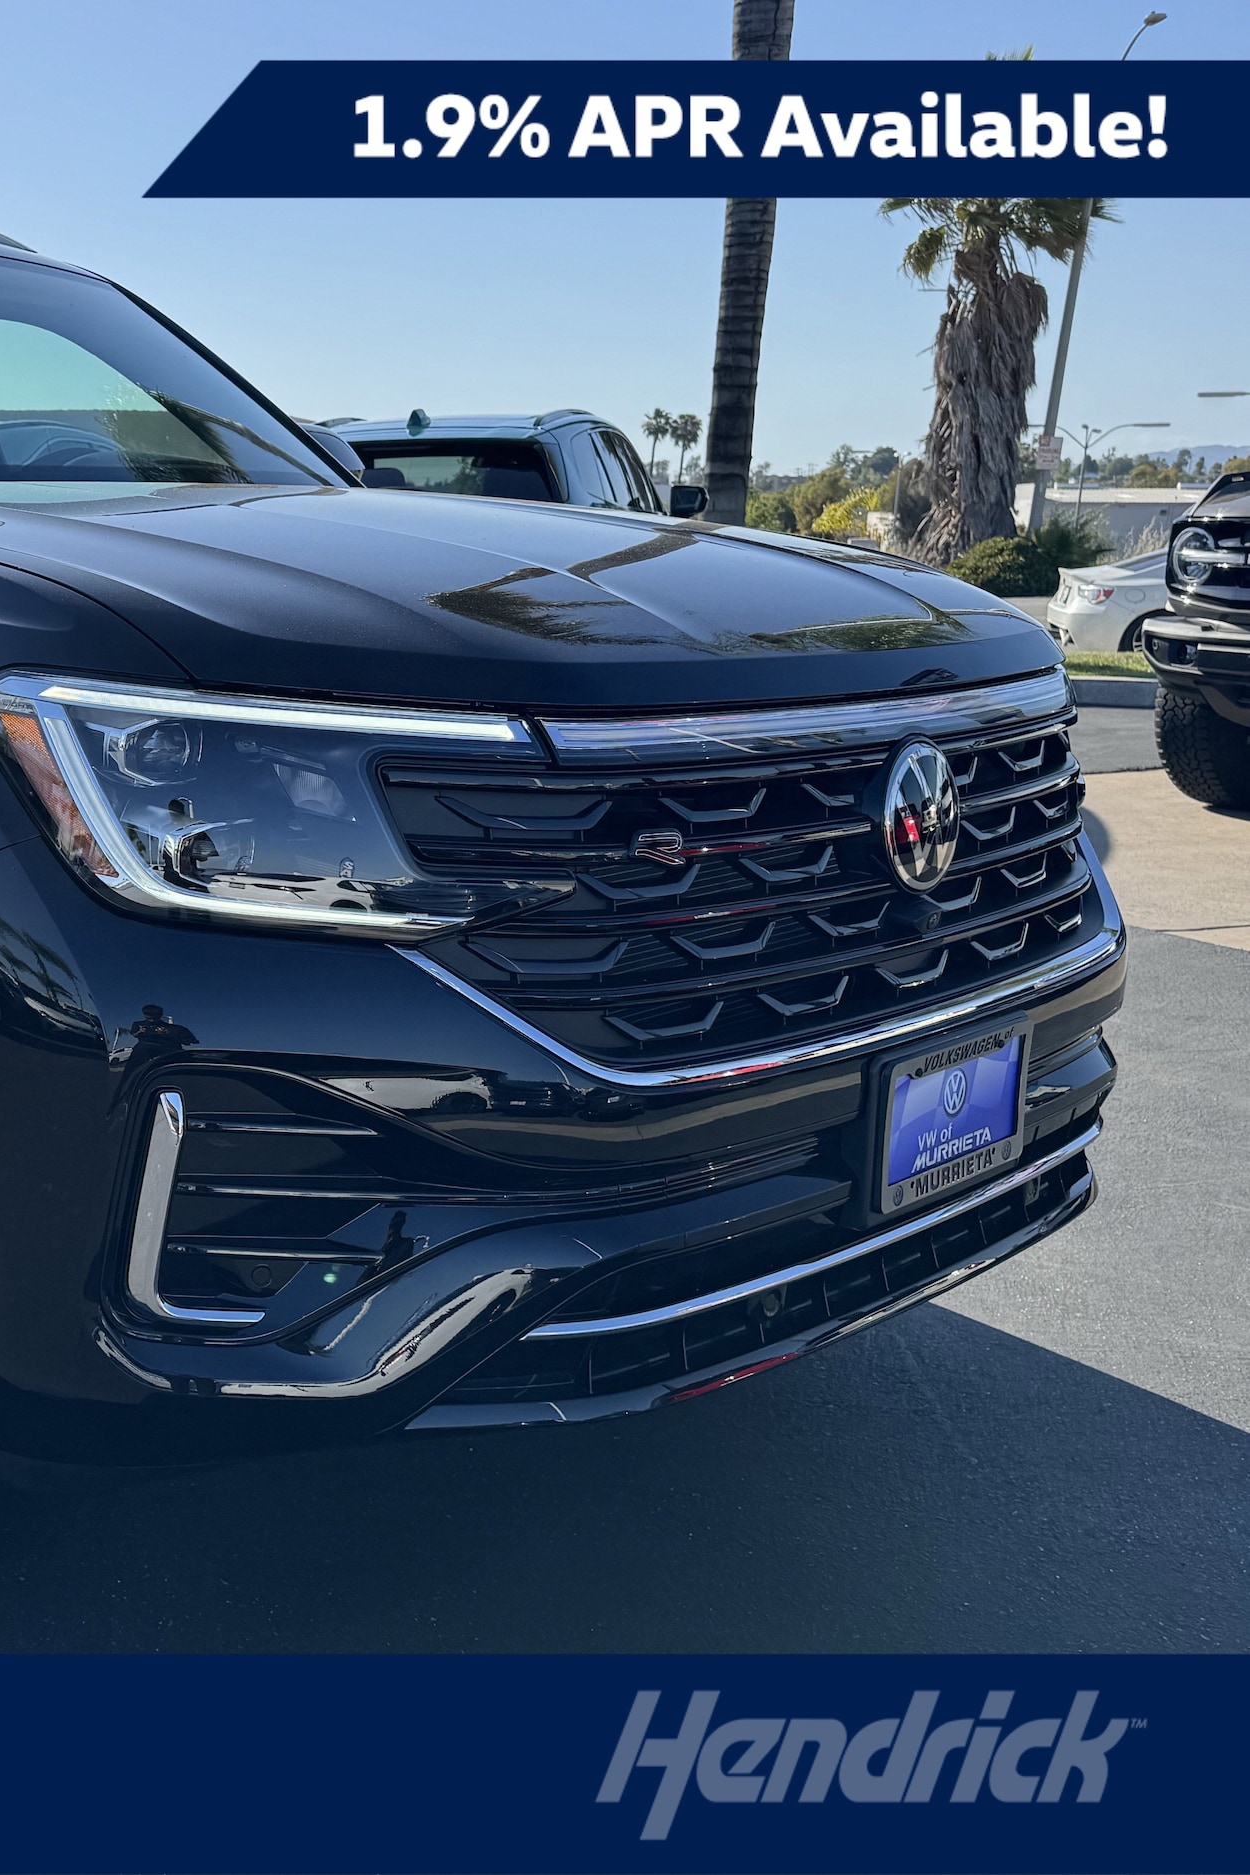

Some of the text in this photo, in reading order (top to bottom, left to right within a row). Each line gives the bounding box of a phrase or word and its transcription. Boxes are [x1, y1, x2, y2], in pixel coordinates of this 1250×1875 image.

[923, 1026, 1015, 1073] VOLKSWAGEN of
[910, 1126, 992, 1174] MURRIETA
[918, 1122, 953, 1152] VW of
